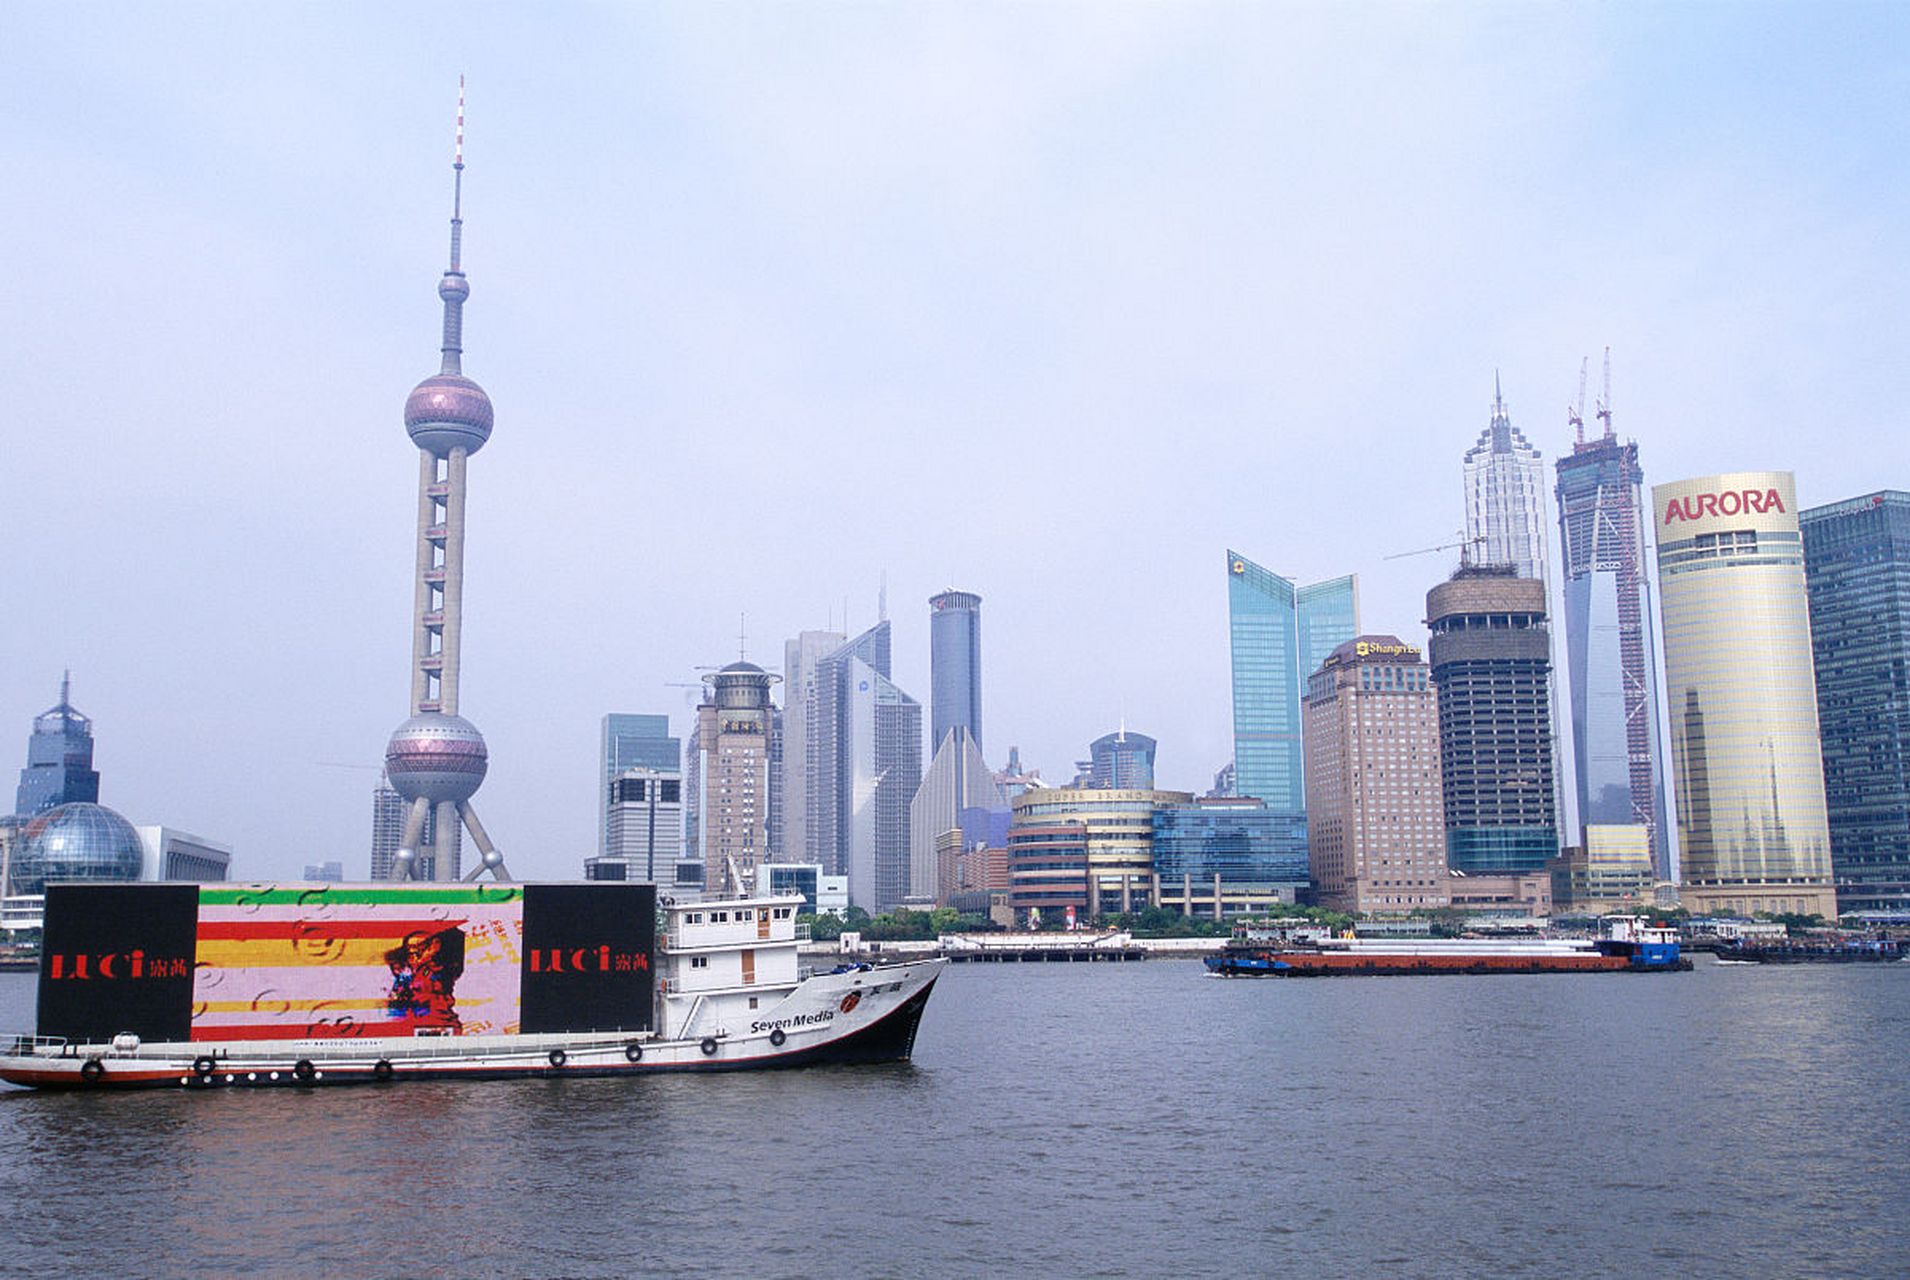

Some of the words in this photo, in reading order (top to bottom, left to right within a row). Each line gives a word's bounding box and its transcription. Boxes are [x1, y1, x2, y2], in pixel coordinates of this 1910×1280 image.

[1665, 489, 1786, 525] AURORA
[751, 1020, 791, 1033] Seven
[793, 1010, 834, 1027] Media
